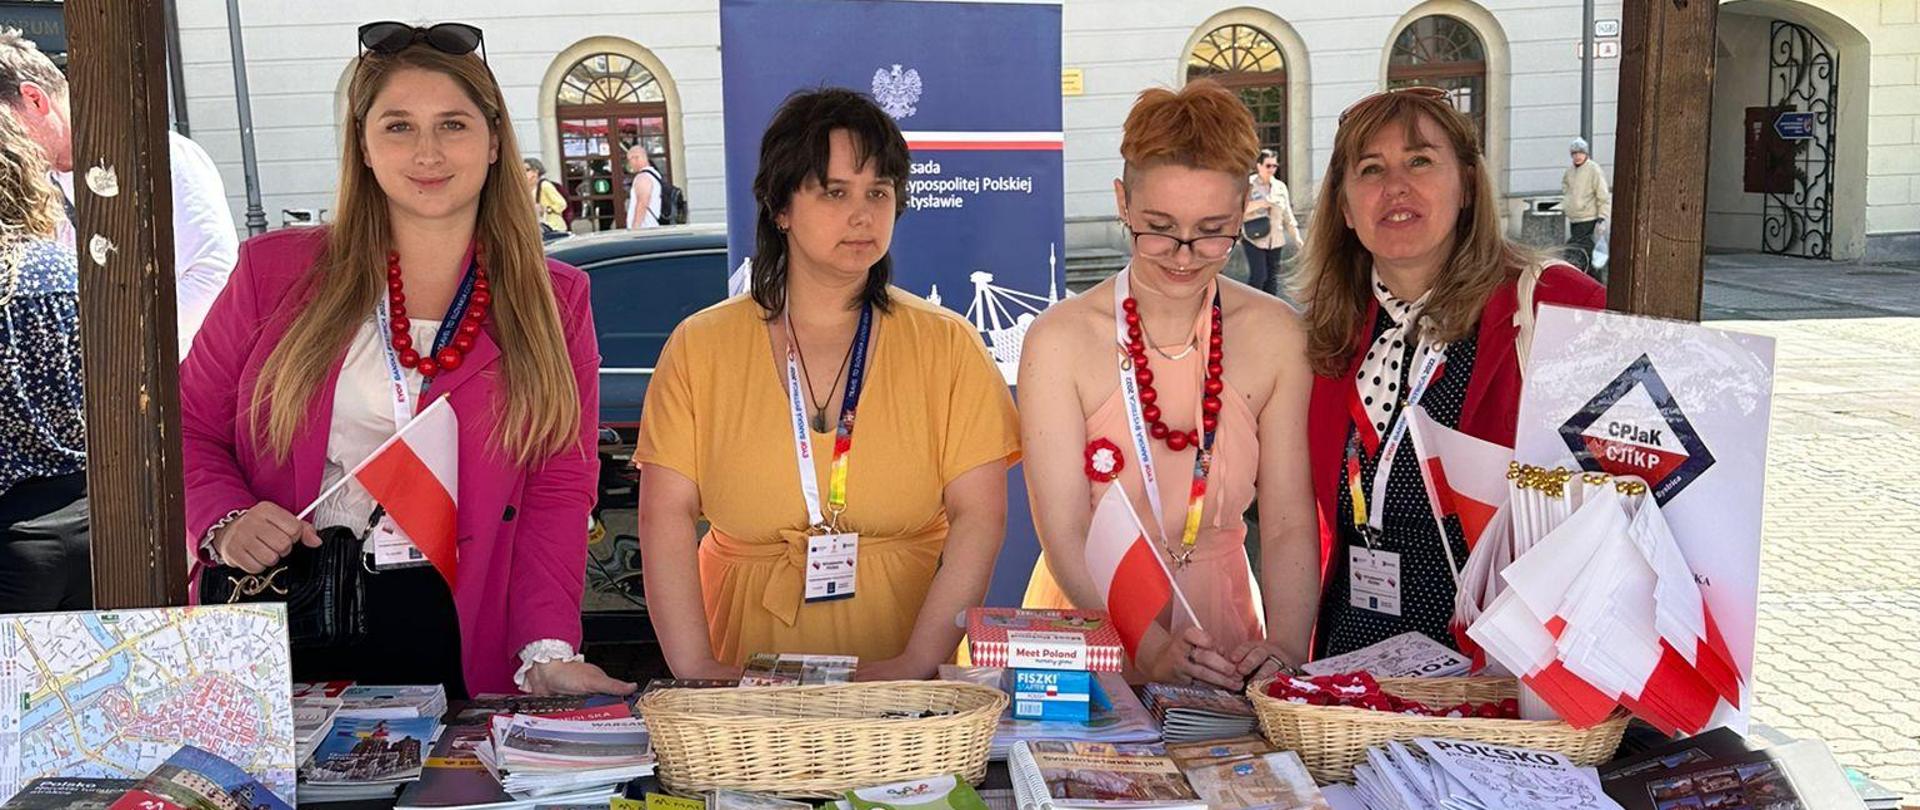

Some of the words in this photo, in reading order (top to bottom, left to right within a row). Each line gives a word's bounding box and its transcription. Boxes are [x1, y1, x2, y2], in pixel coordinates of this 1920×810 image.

[906, 177, 980, 194] ypospolitej
[983, 176, 1032, 193] Polskiej
[906, 194, 963, 211] tysławie
[1608, 421, 1662, 447] CPJaK
[1016, 648, 1040, 658] Meet
[1042, 649, 1077, 659] Poland
[1017, 673, 1057, 684] FISZKI
[1433, 741, 1560, 765] POĽSKO
